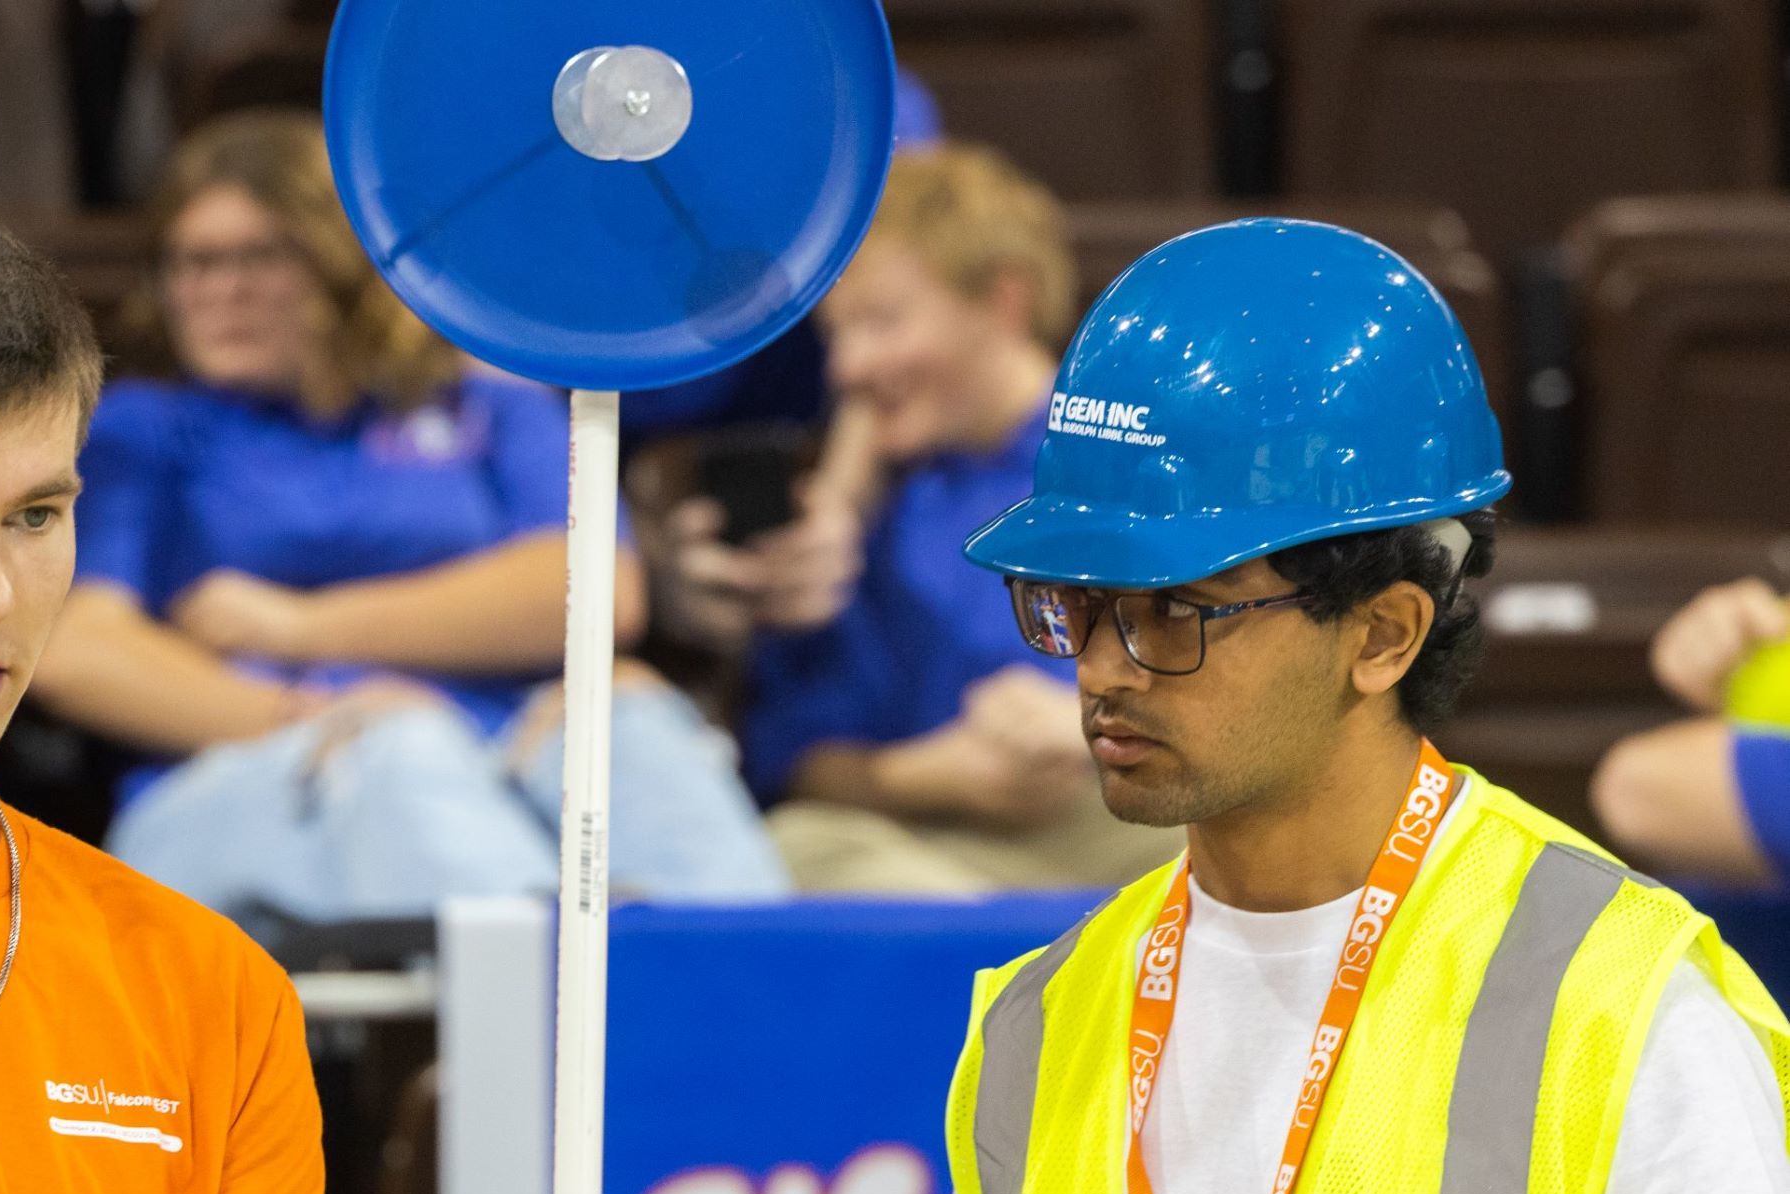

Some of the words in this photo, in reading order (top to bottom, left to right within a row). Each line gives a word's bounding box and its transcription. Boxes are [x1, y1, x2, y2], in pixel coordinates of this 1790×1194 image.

[1065, 395, 1106, 425] GEM
[1106, 402, 1150, 431] INC
[1124, 431, 1167, 447] GROUP
[1384, 763, 1449, 863] BGSU
[1140, 903, 1184, 1002] BGSU
[1334, 885, 1398, 992] BGSU
[1290, 1023, 1343, 1130] BGSU
